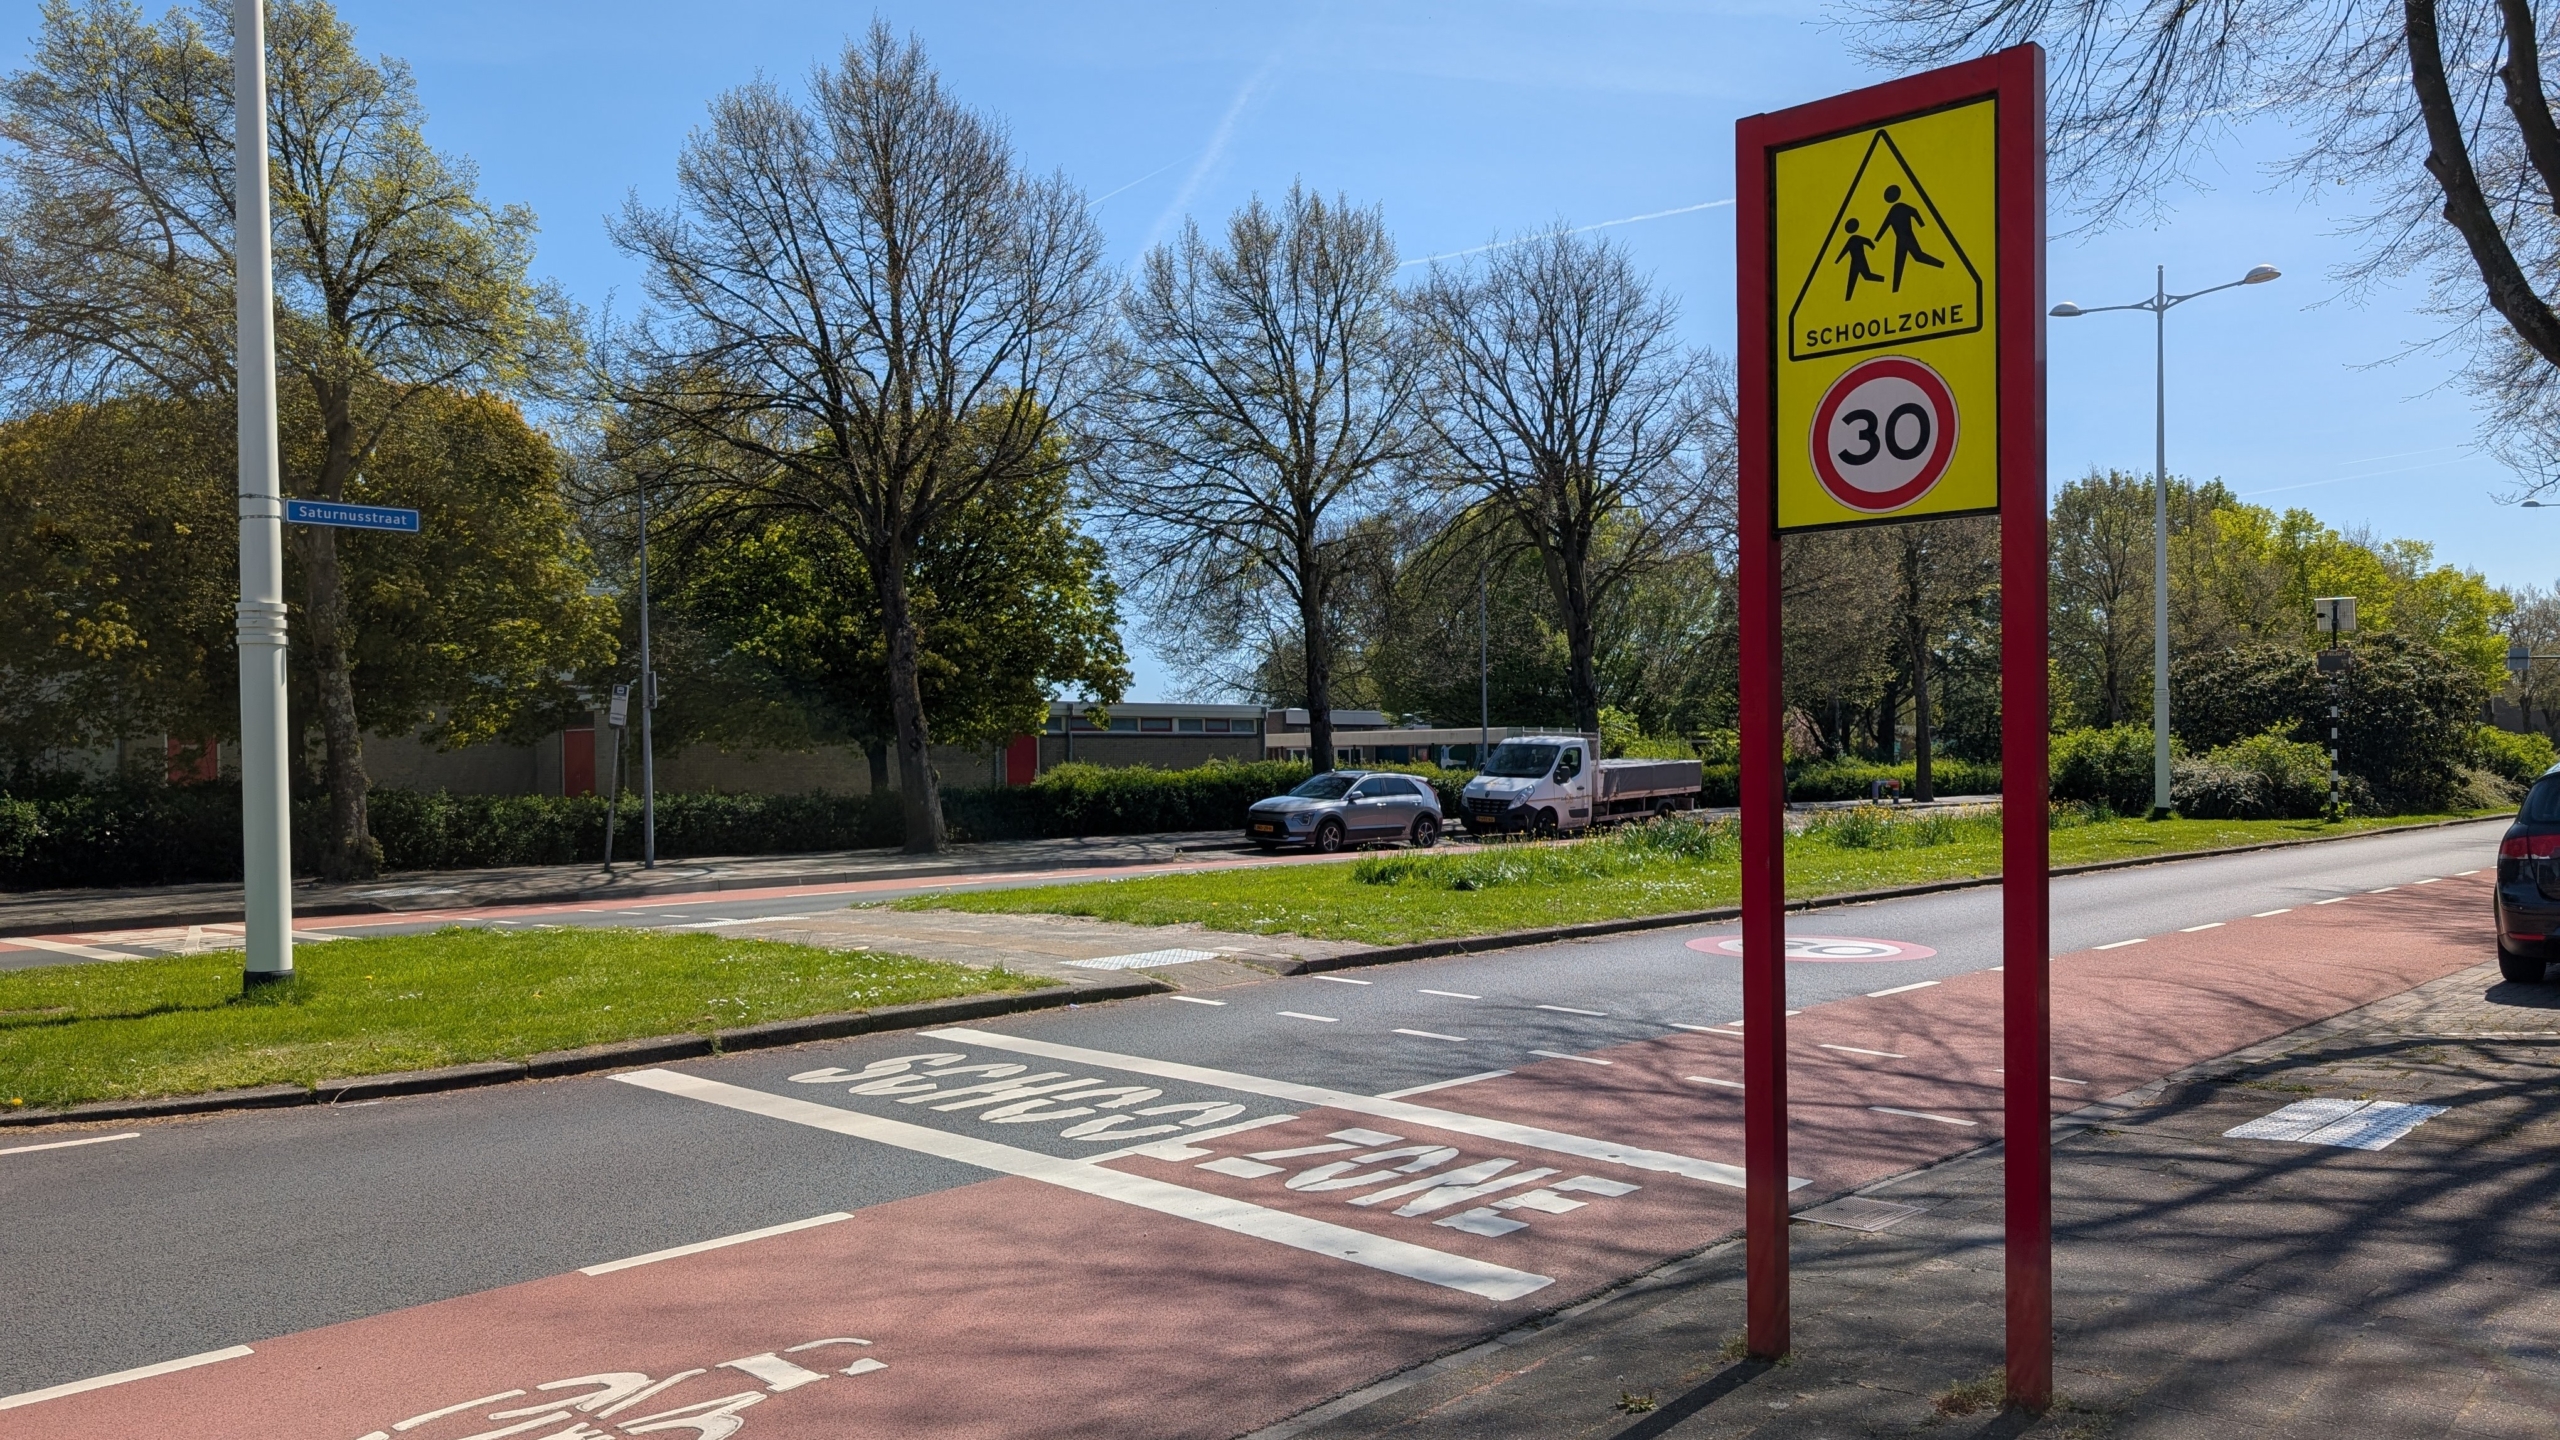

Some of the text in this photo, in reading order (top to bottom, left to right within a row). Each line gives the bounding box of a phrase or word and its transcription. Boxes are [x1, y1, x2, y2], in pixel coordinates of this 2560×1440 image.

[1806, 304, 1963, 346] SCHOOLZONE
[1838, 403, 1930, 465] 30
[299, 507, 407, 525] Saturnusstraat
